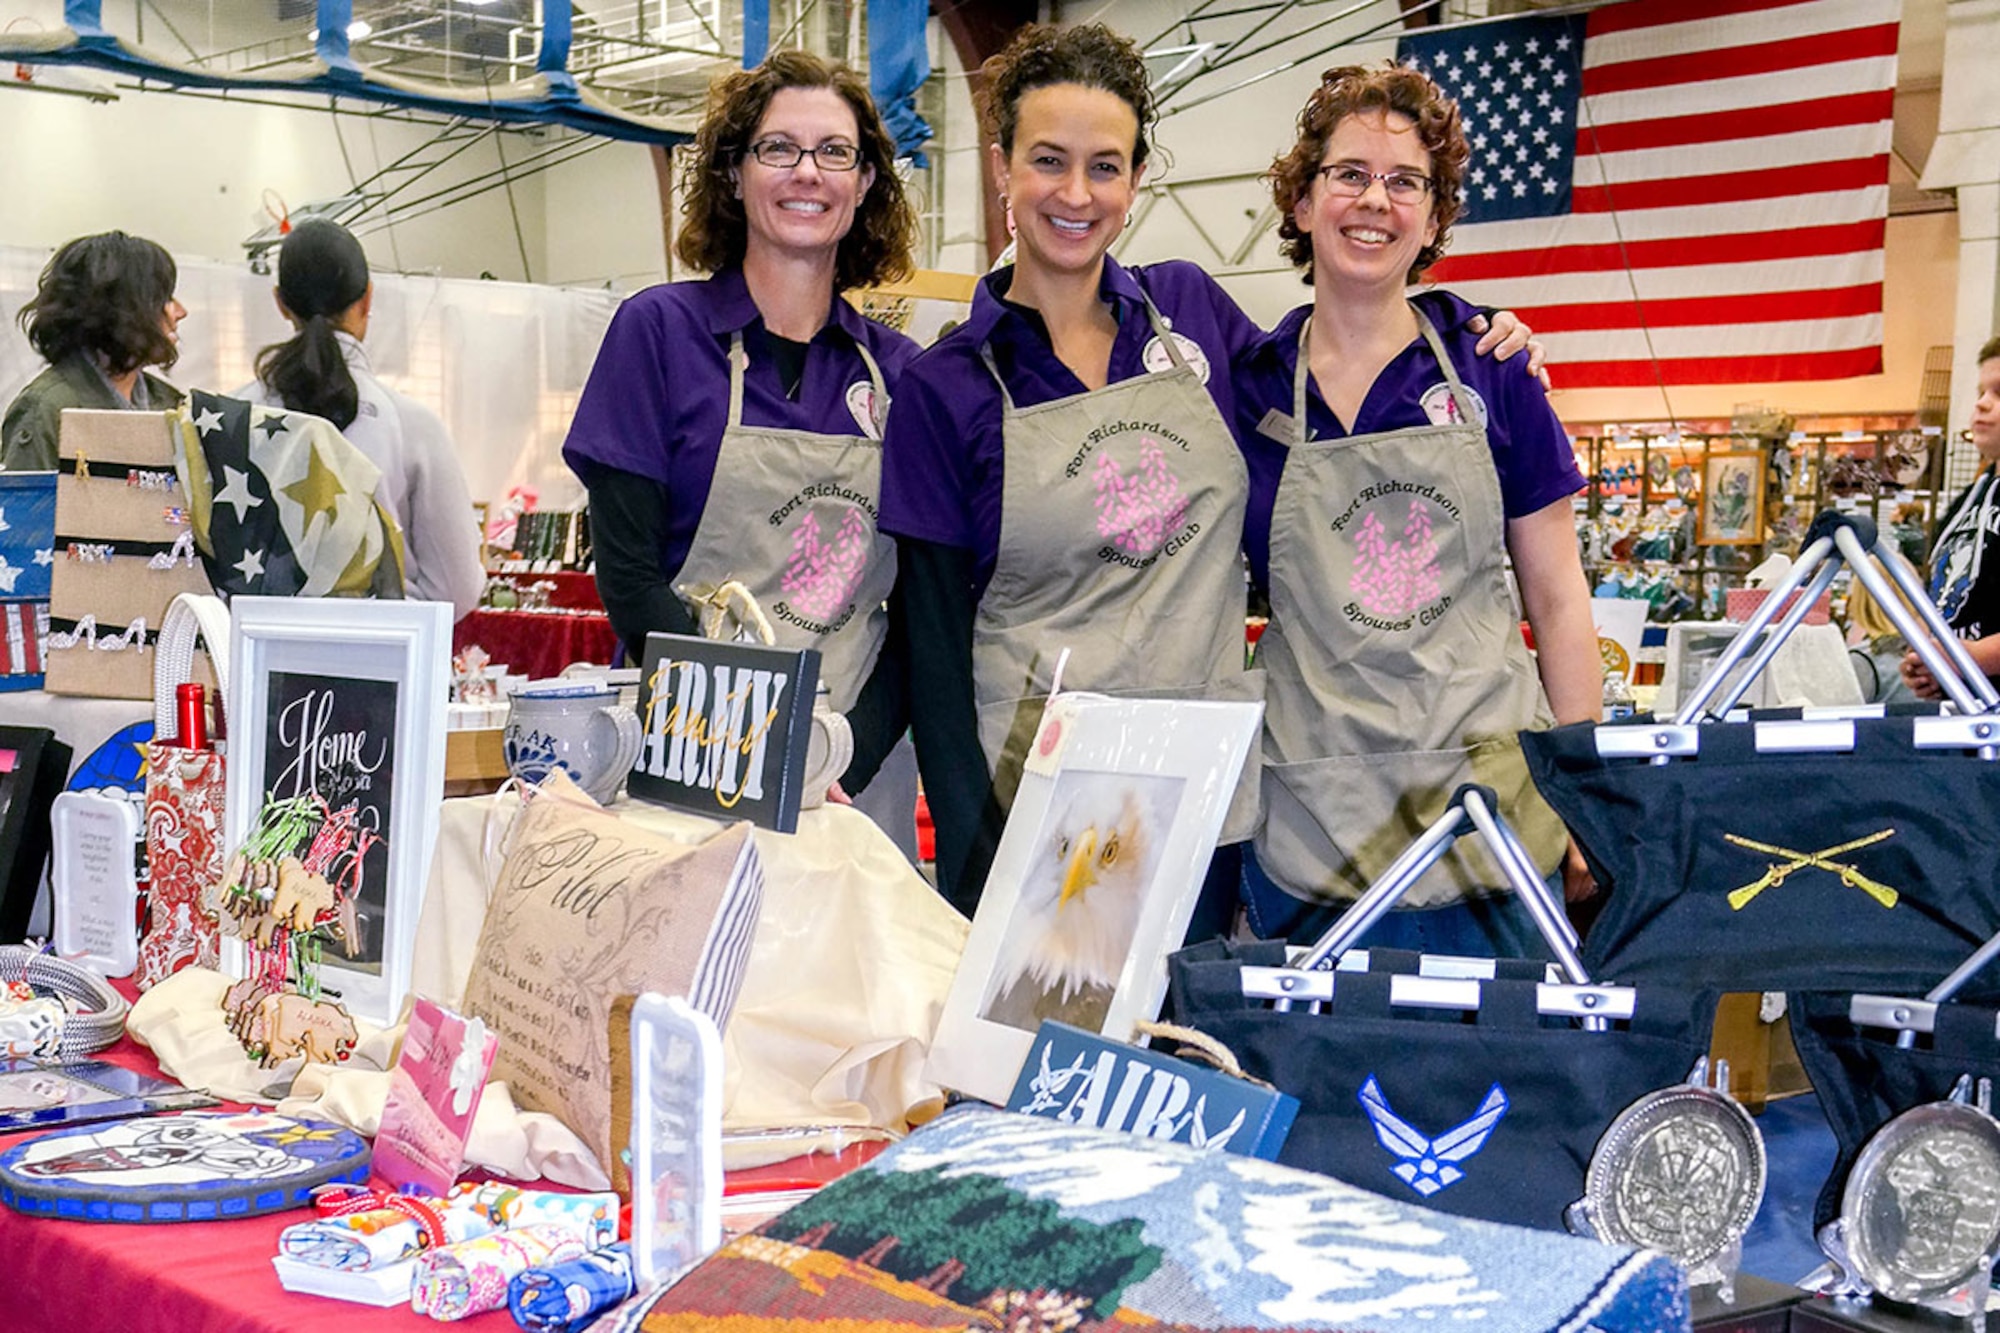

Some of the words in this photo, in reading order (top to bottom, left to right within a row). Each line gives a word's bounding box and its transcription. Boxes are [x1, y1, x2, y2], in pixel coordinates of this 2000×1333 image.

[1065, 441, 1092, 478] Fort
[1088, 420, 1190, 452] Richardson
[769, 494, 806, 527] Fort
[803, 483, 879, 520] Richardso
[1331, 499, 1361, 532] Fort
[1359, 480, 1461, 521] Richardson
[1164, 522, 1200, 557] Club
[1343, 602, 1415, 632] Spouses'
[1419, 595, 1454, 626] Club
[272, 689, 387, 798] Home
[527, 729, 557, 755] AK
[635, 657, 788, 800] ARMY
[643, 660, 778, 808] Family
[1058, 1050, 1193, 1141] AIR
